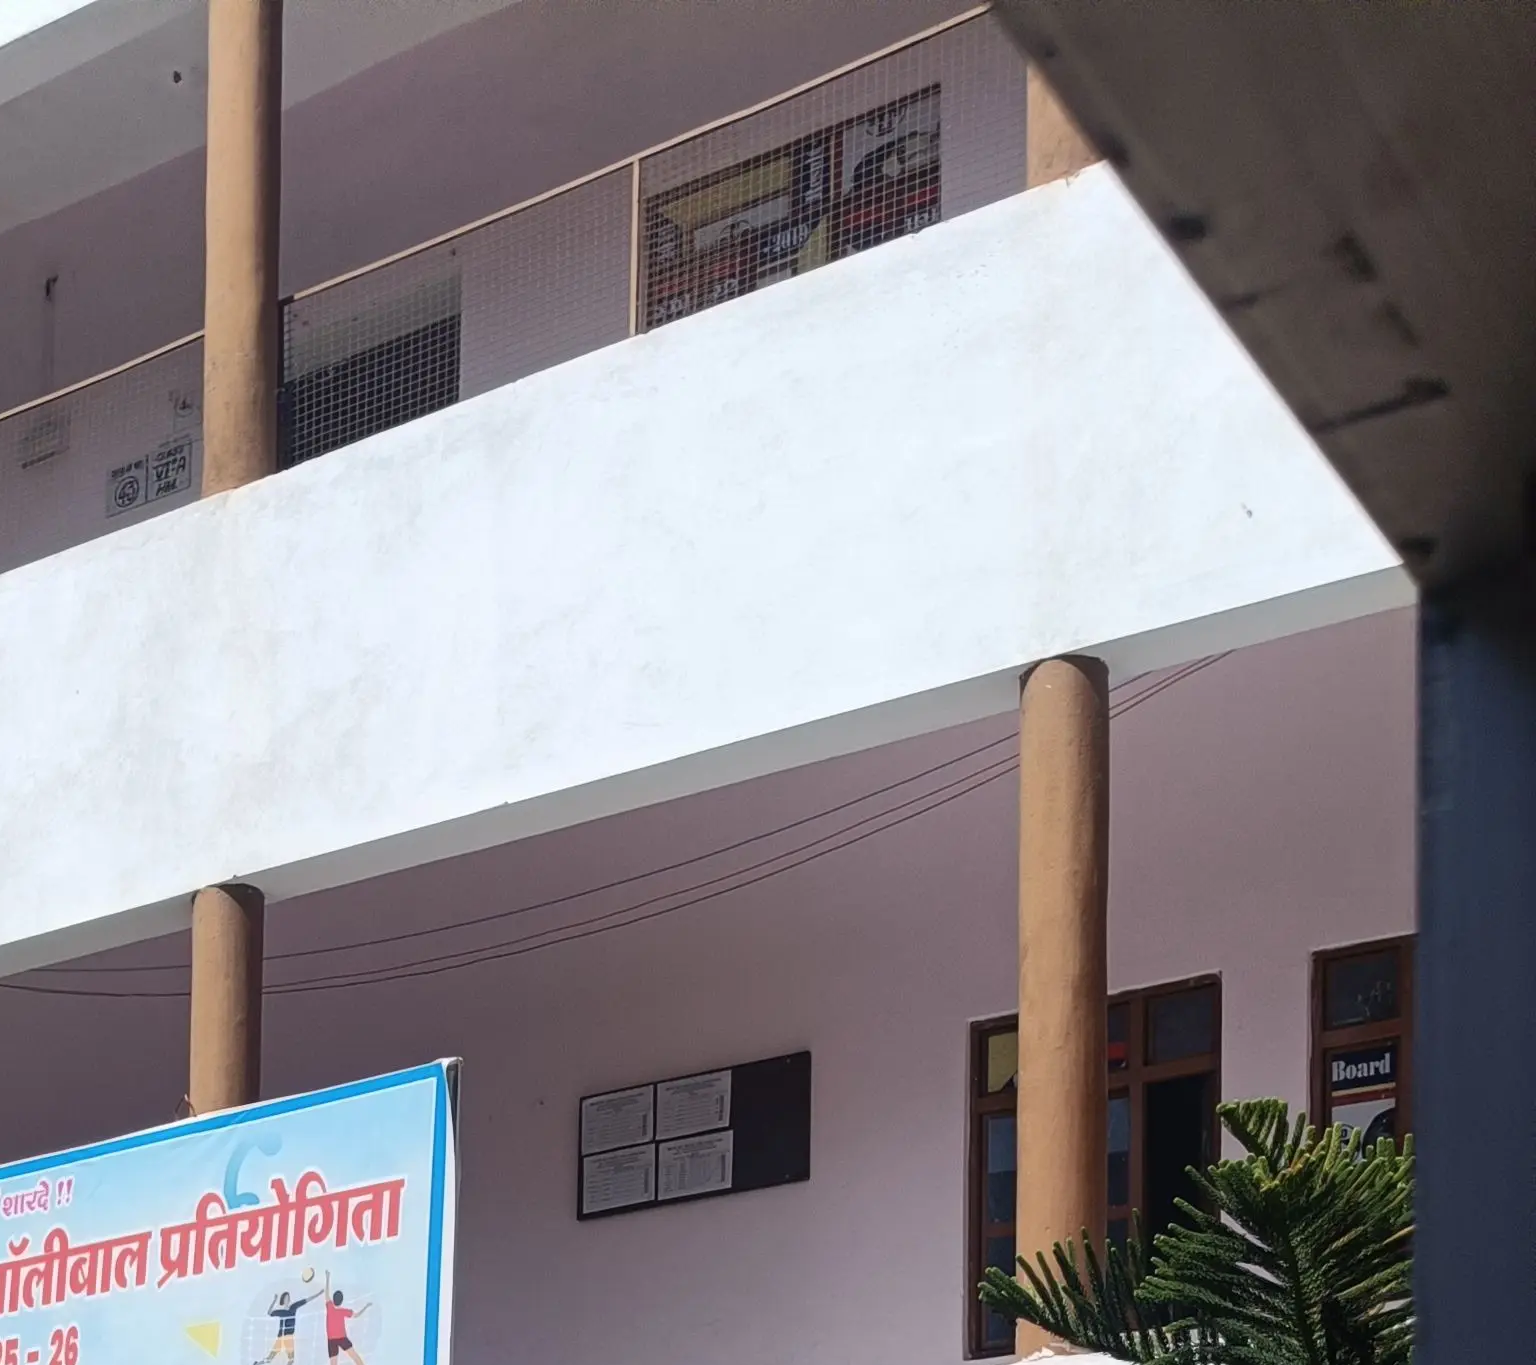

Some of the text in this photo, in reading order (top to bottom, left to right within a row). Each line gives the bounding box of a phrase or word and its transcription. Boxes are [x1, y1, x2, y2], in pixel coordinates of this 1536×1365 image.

[1331, 1053, 1391, 1082] Board
[3, 1181, 49, 1216] शारदे
[158, 1171, 406, 1289] प्रतियोगिता
